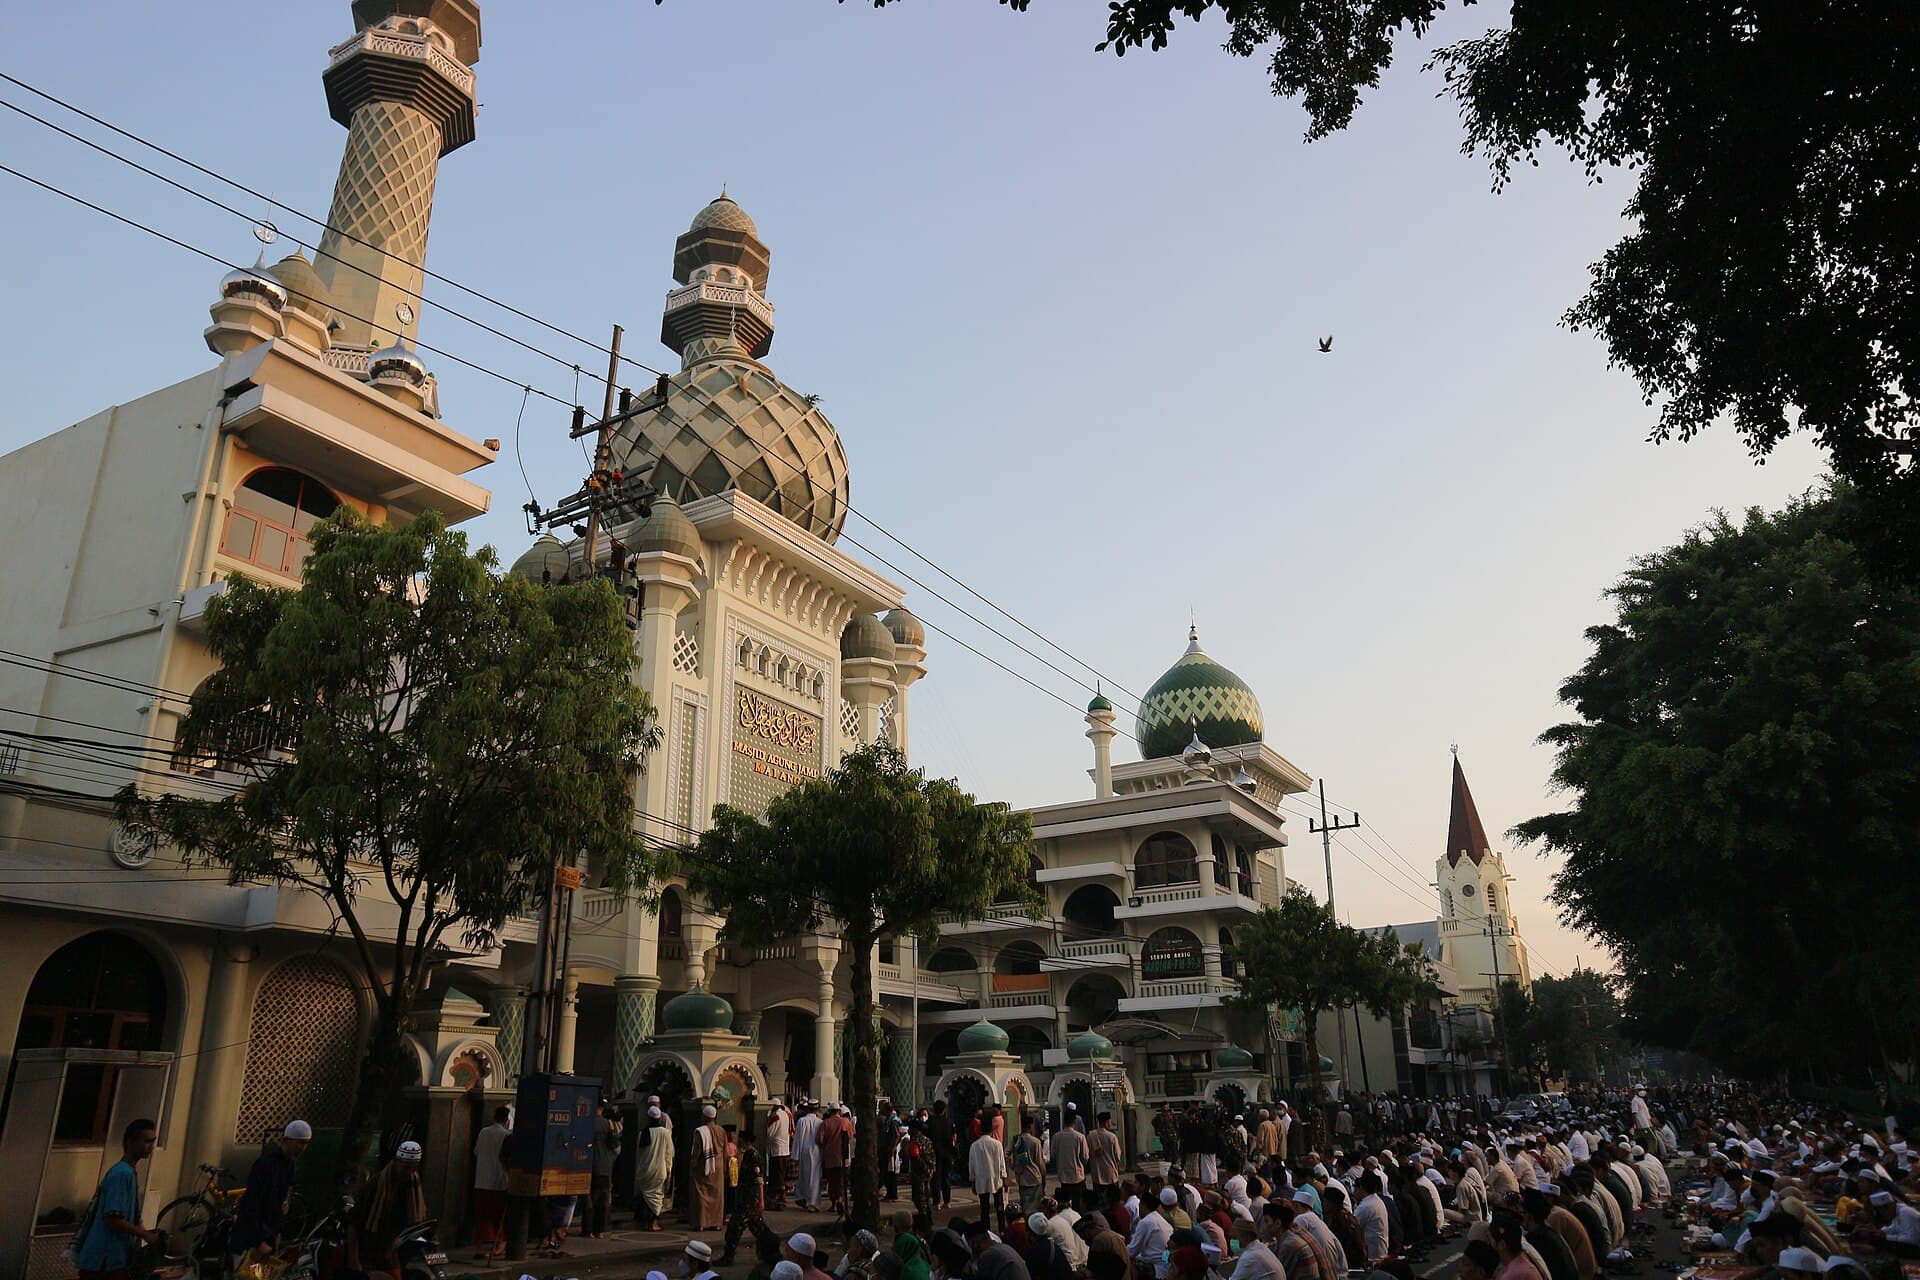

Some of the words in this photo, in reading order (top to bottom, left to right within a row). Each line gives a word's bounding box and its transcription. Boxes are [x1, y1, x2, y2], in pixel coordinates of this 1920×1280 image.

[732, 741, 765, 761] MASJID
[766, 754, 796, 772] AGUNG
[754, 762, 801, 786] MALANG
